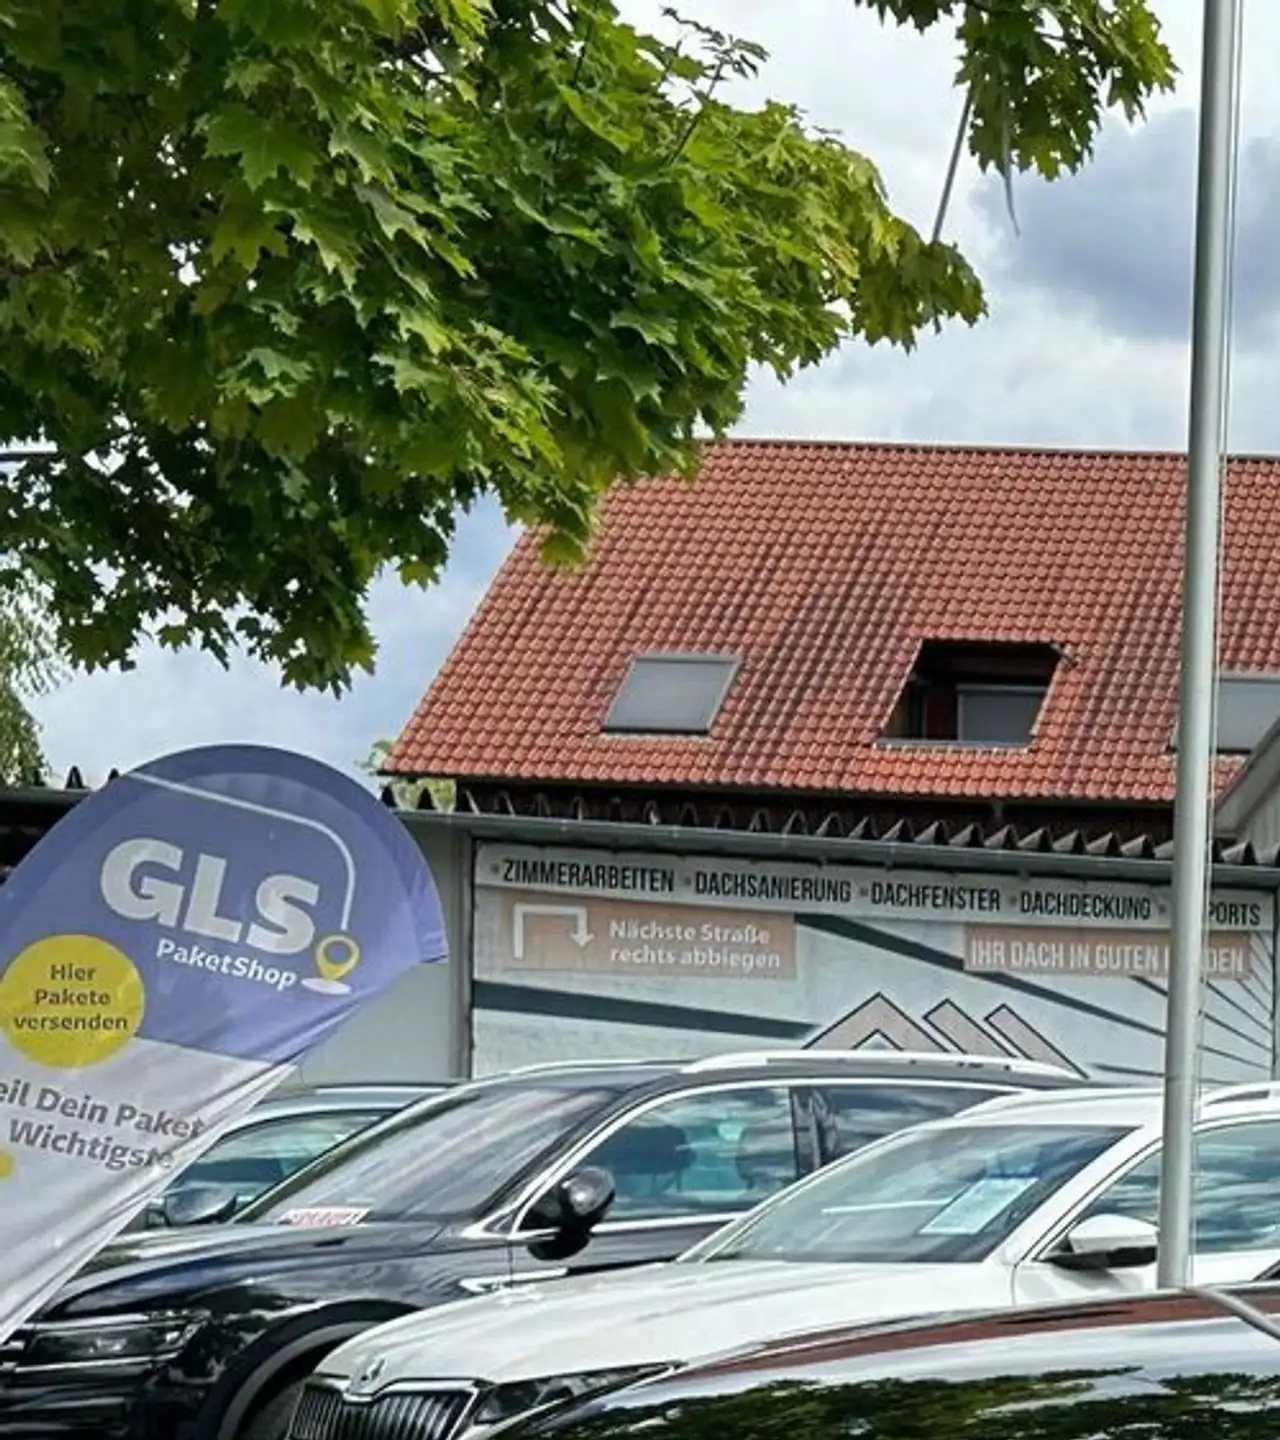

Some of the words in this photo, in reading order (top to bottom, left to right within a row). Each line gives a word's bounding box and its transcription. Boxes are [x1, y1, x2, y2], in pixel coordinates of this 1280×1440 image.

[101, 837, 320, 955] GLS
[502, 858, 675, 893] ZIMMERARBEITEN
[694, 871, 852, 904] DACHSANIERUNG
[870, 881, 1001, 913] DACHFENSTER
[1020, 890, 1152, 921] DACHDECKUNG
[1208, 901, 1261, 926] PORTS
[609, 918, 696, 942] Nächste
[701, 921, 771, 945] Straße
[156, 938, 297, 990] PaketShop
[610, 943, 675, 966] rechts
[680, 946, 781, 973] abbiegen
[971, 939, 1005, 967] IHR
[1010, 940, 1064, 968] DACH
[1069, 942, 1090, 969] IN
[1095, 943, 1159, 972] GUTEN
[50, 963, 97, 982] Hier
[34, 988, 112, 1006] Pakete
[14, 1013, 129, 1032] versenden
[35, 1086, 110, 1125] Dein
